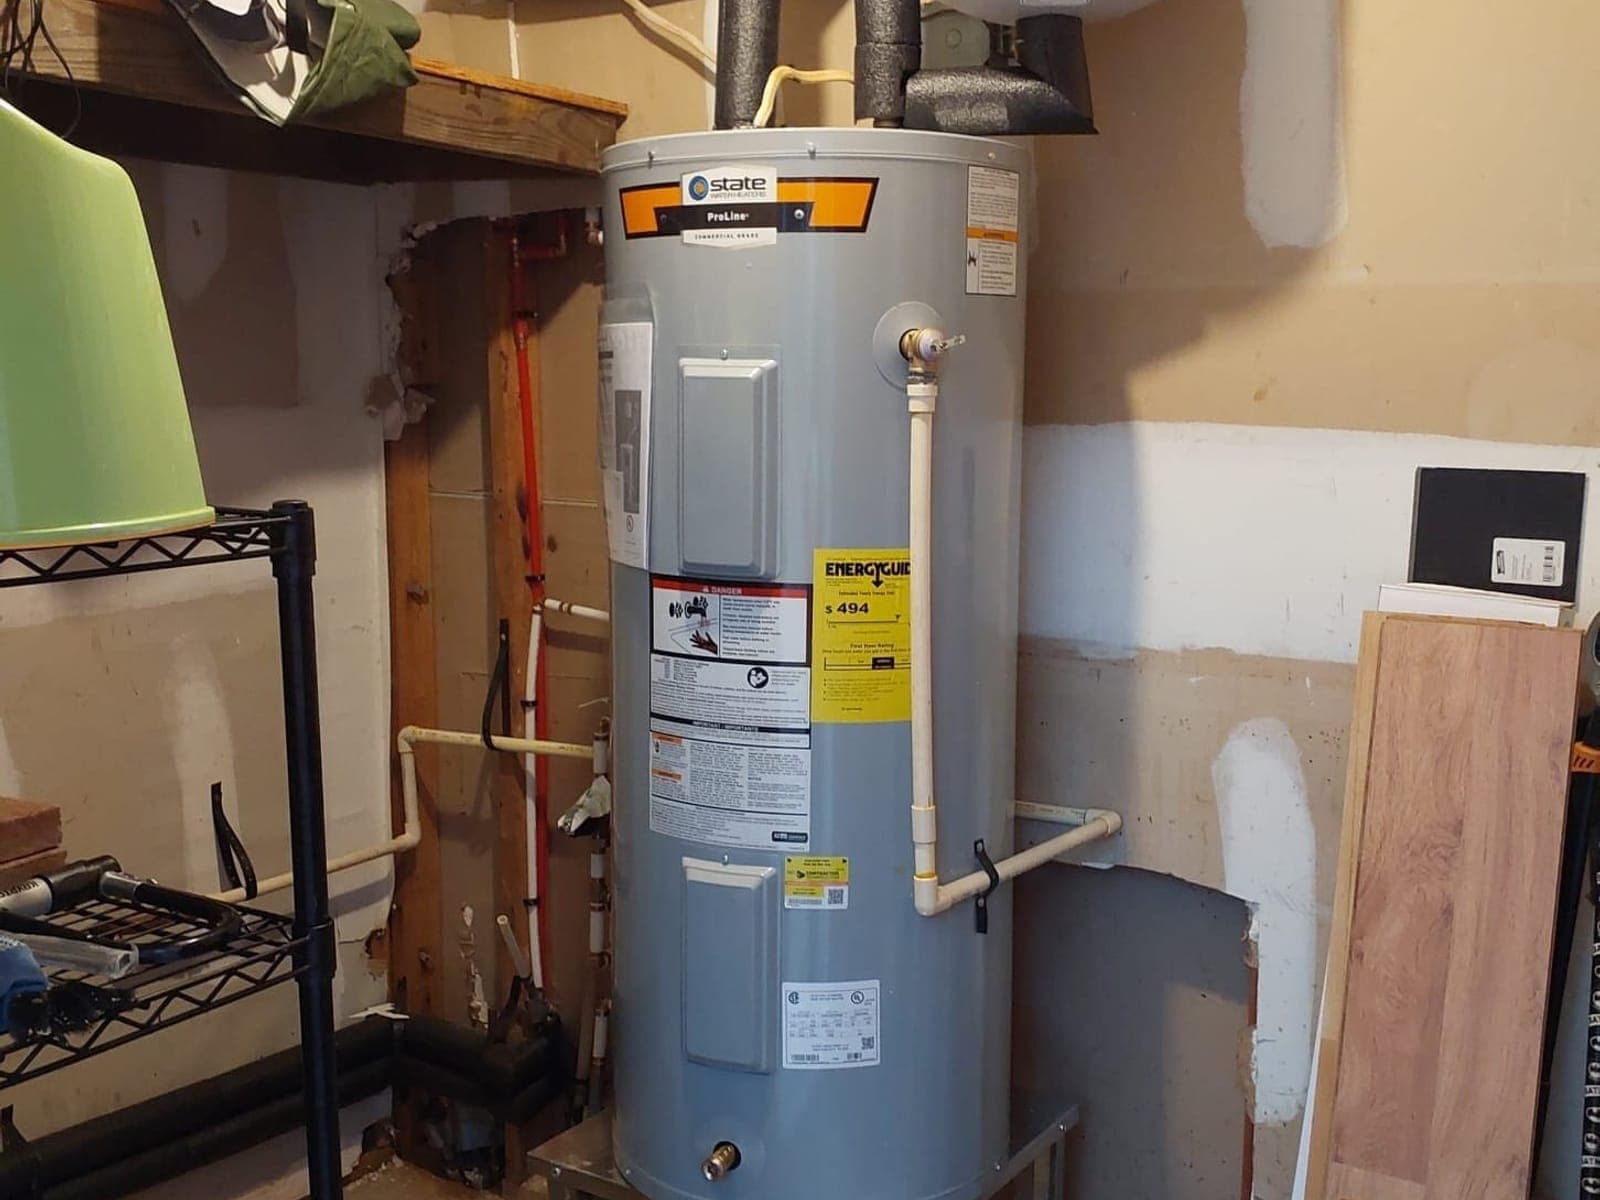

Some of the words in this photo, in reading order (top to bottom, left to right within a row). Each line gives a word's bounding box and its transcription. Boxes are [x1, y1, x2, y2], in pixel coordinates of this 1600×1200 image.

[710, 177, 766, 191] state
[825, 561, 911, 580] ENERGYGUID
[836, 602, 869, 614] 494
